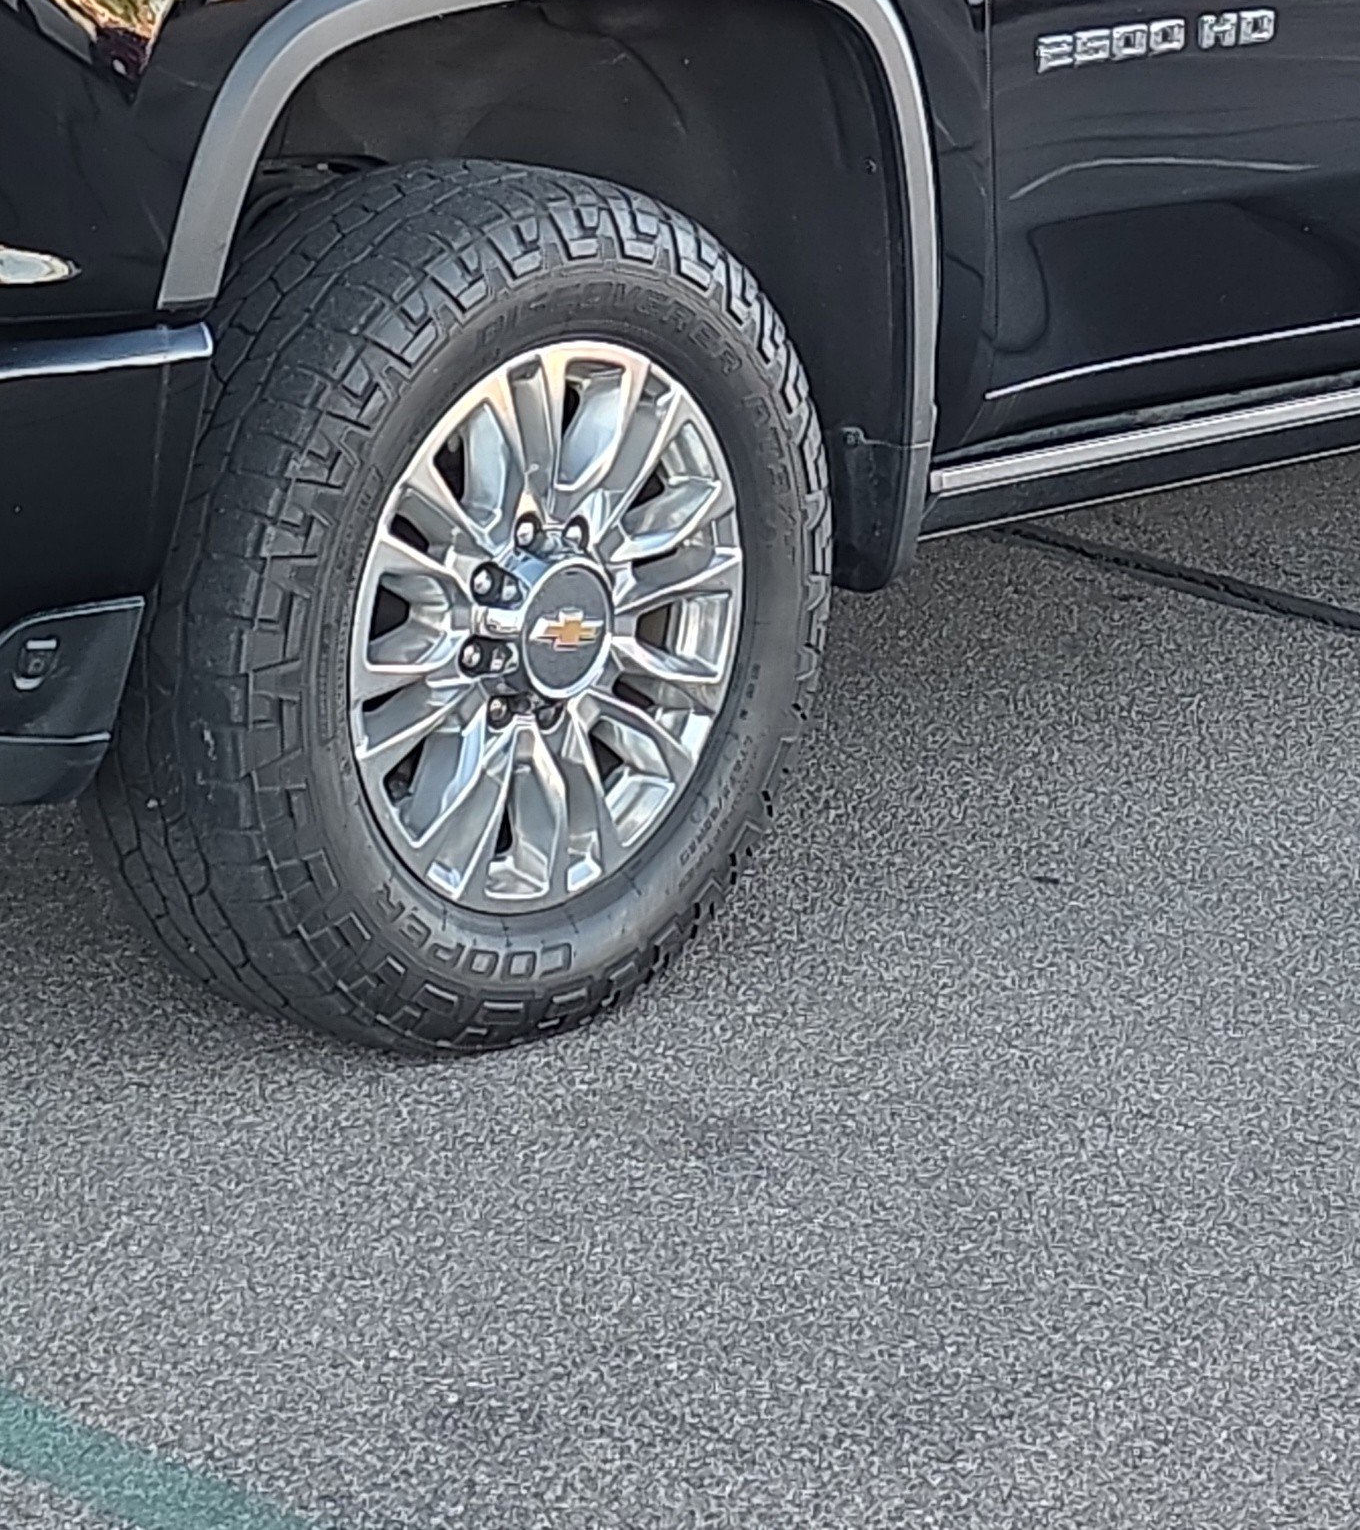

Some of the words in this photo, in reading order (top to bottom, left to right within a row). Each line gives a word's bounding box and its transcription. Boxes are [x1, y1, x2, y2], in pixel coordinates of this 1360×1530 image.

[1036, 17, 1186, 74] 2500
[1197, 9, 1276, 50] HD
[476, 281, 744, 376] DISCOVERER
[374, 881, 574, 982] COOPER
